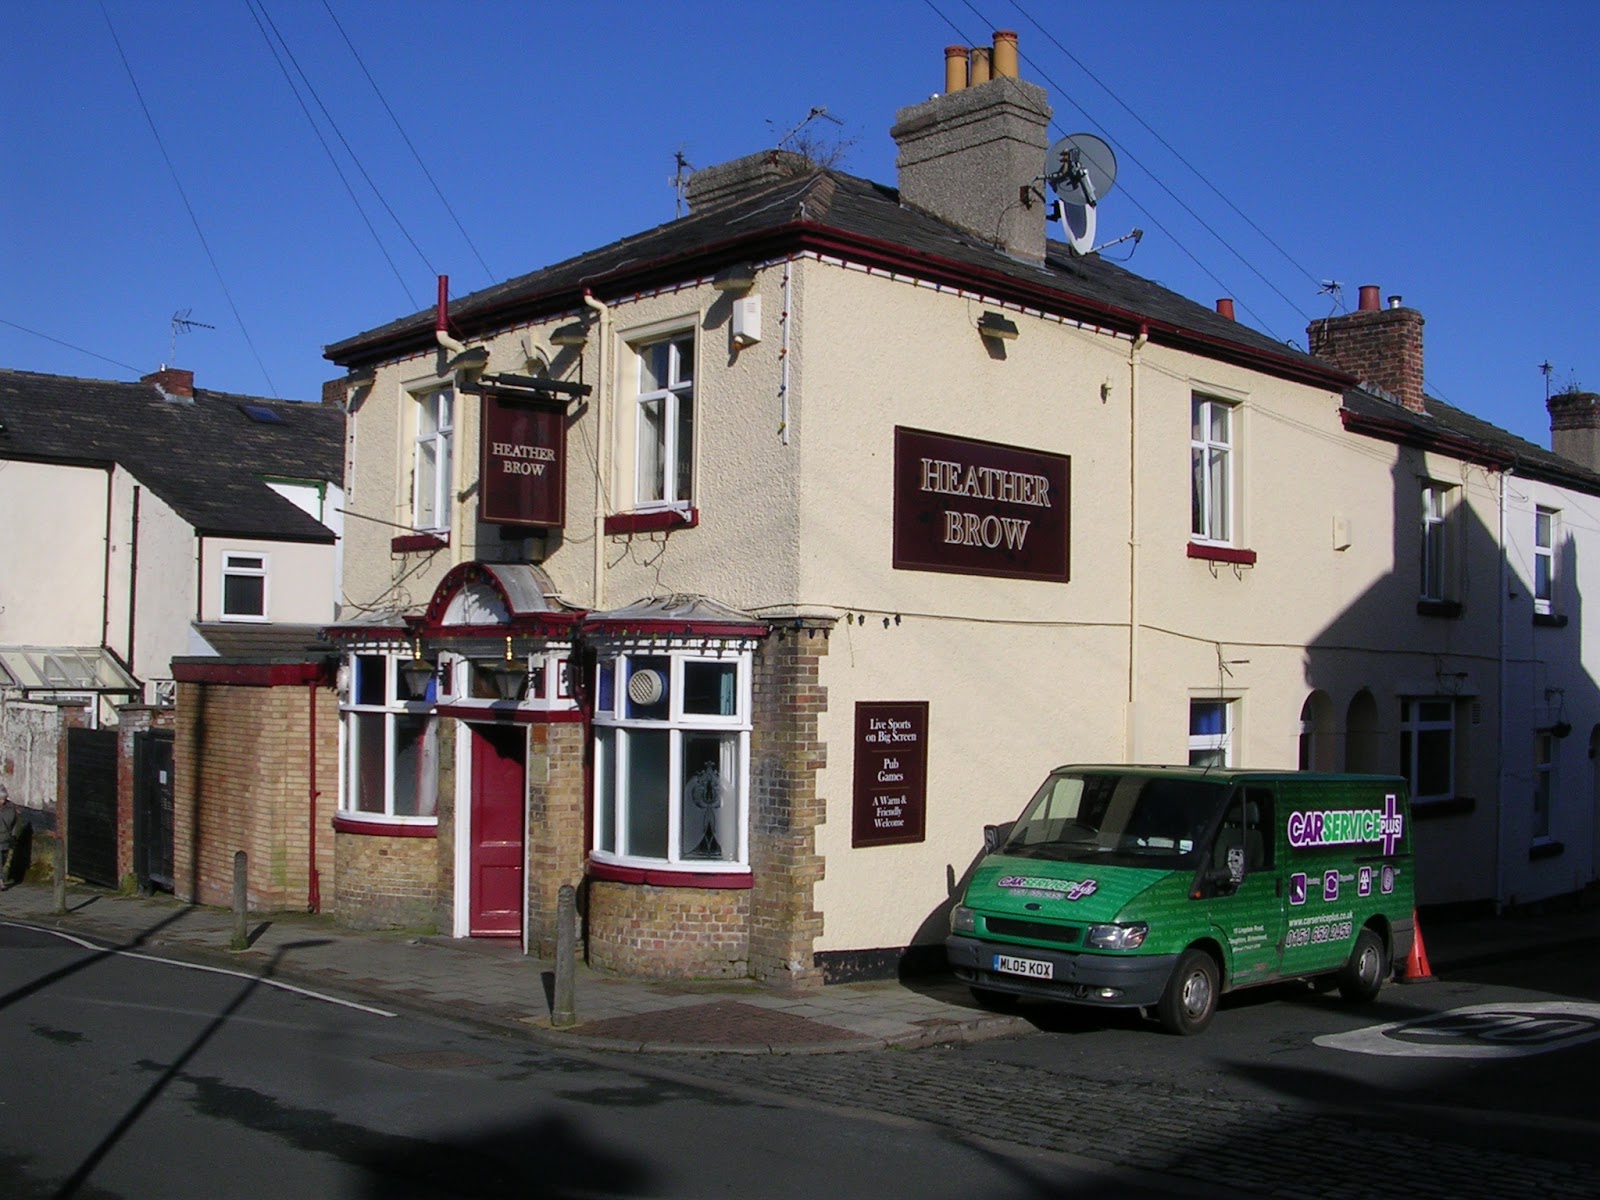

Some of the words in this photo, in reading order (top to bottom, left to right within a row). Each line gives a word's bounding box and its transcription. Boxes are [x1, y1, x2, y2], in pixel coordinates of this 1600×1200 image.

[492, 442, 556, 461] HEATHER
[503, 460, 545, 476] BROW
[920, 457, 1052, 508] HEATHER
[944, 510, 1031, 551] BROW
[870, 718, 886, 730] Live
[888, 718, 911, 732] Sports
[865, 734, 876, 743] on
[878, 731, 891, 744] Big
[892, 731, 916, 742] Screen
[883, 758, 899, 769] Pub
[877, 771, 903, 782] Games
[872, 797, 879, 806] A
[880, 796, 901, 806] Warm
[901, 795, 907, 805] &
[876, 806, 902, 818] Friendly
[874, 818, 904, 828] Welcome
[1000, 957, 1026, 973] ML05
[1028, 963, 1051, 976] KOX
